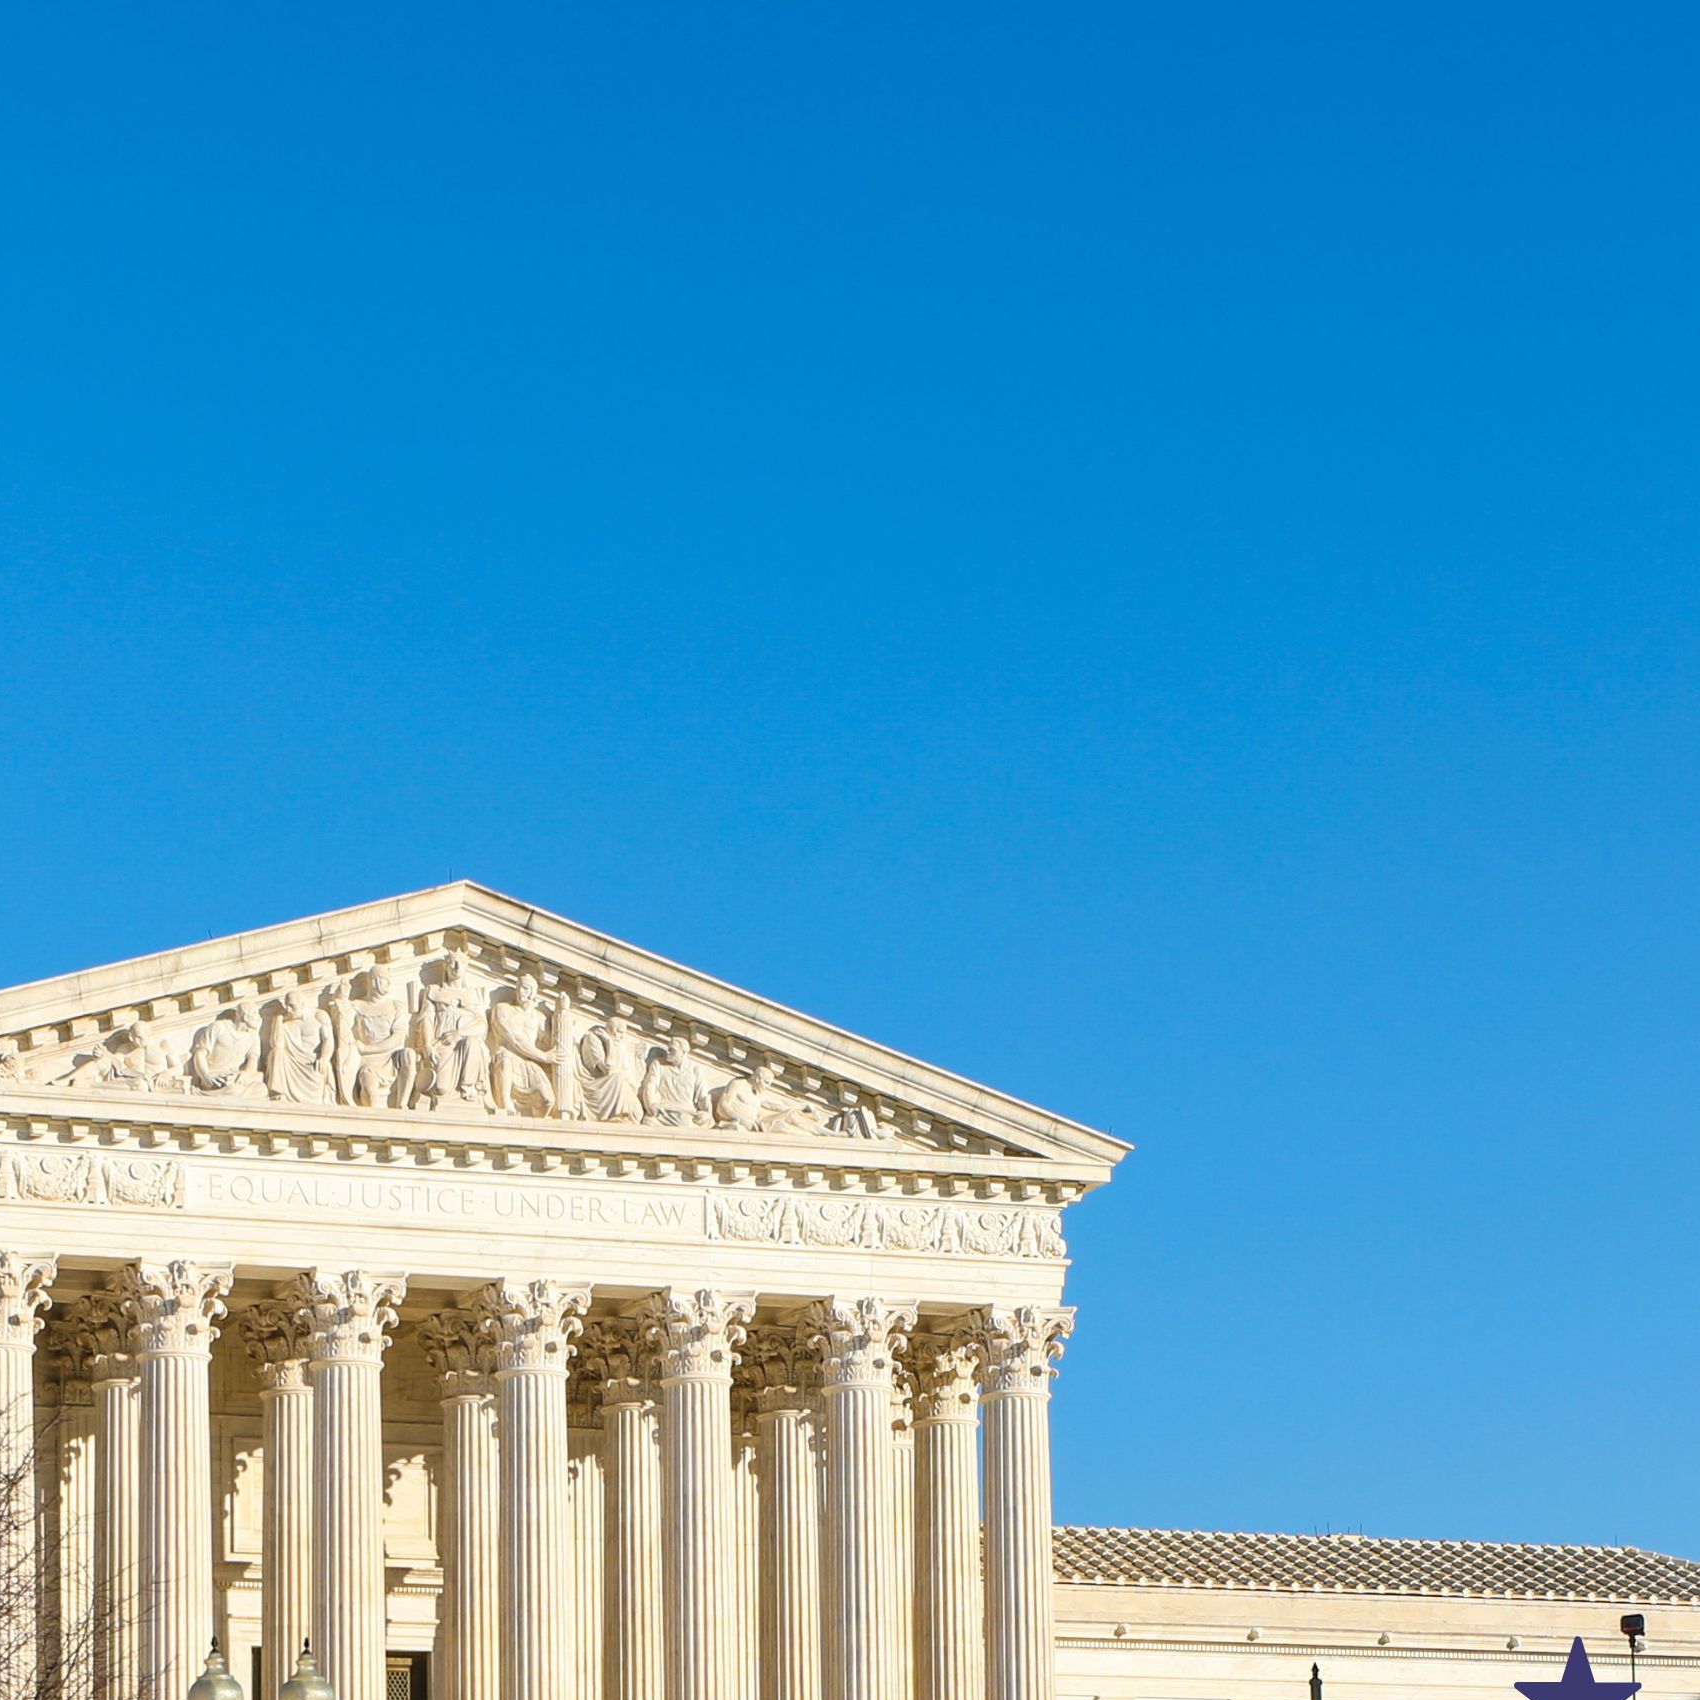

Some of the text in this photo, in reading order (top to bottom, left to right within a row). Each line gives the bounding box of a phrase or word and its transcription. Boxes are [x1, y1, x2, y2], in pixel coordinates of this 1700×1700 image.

[208, 1174, 689, 1227] EQUAL JUSTICE UNDER LAW
